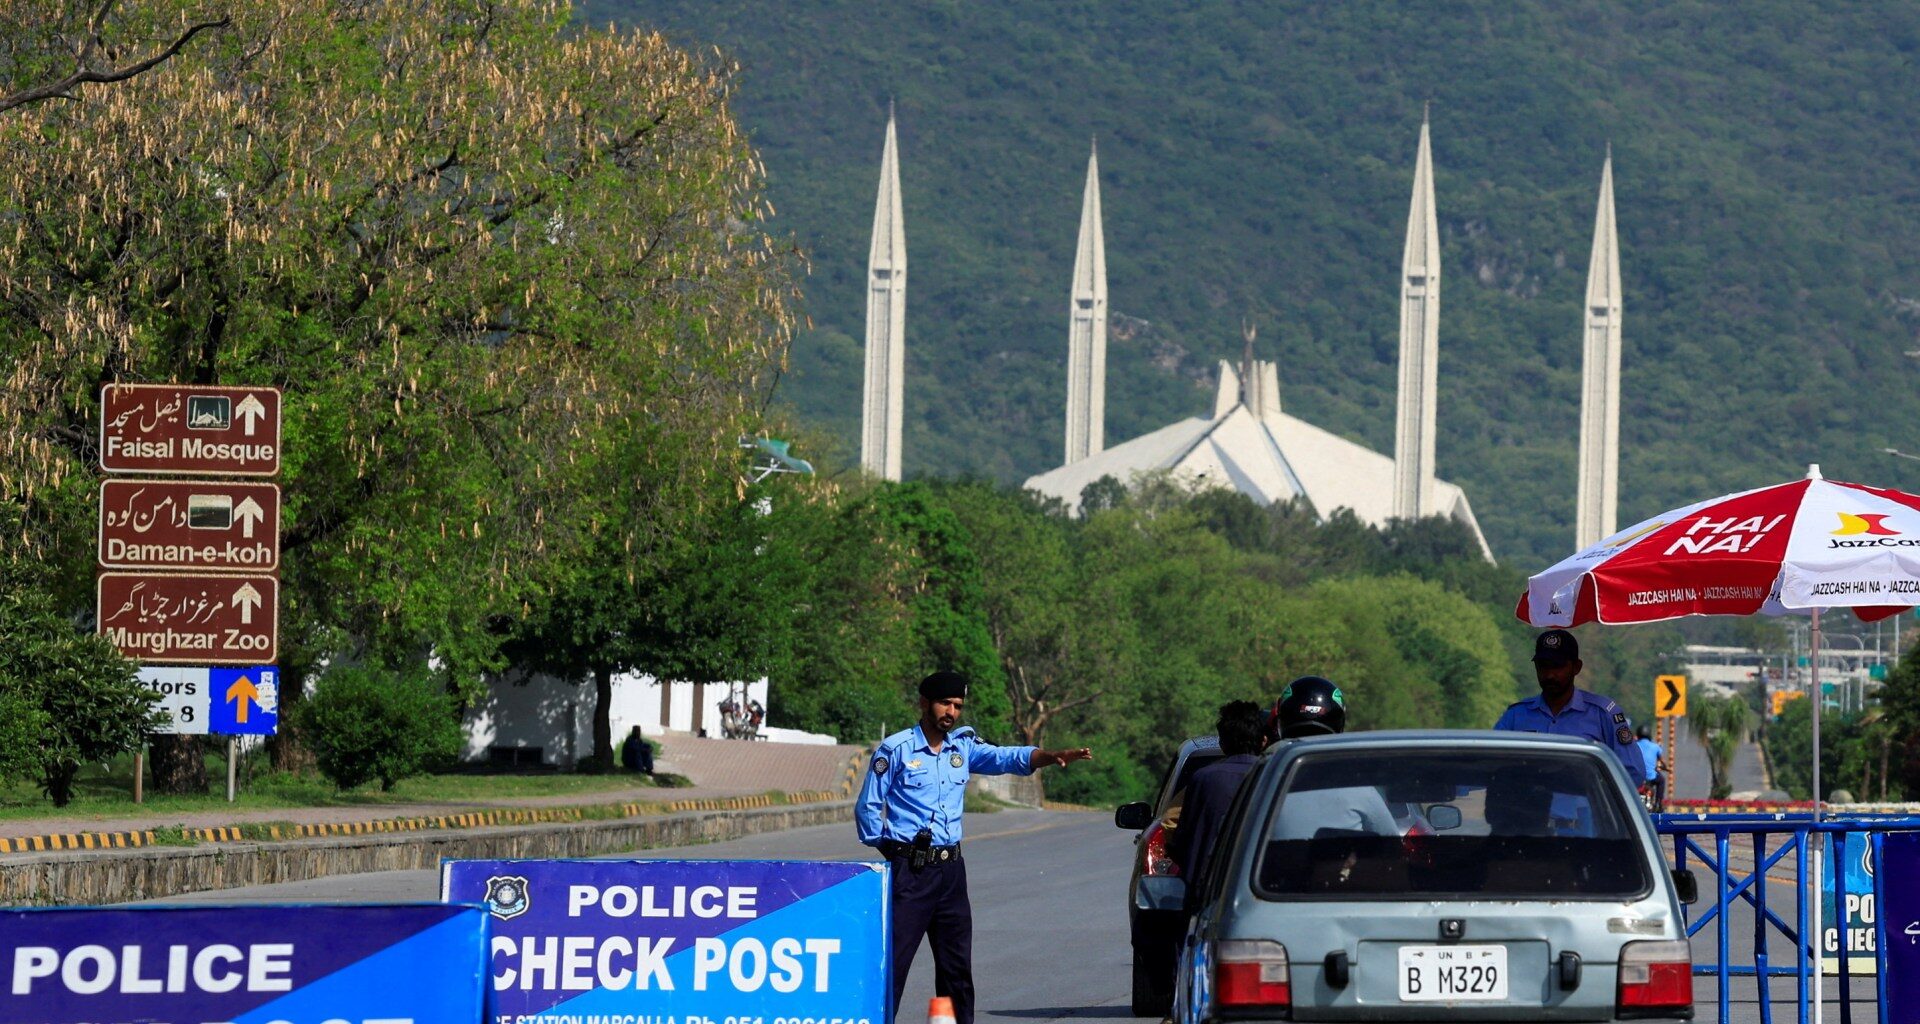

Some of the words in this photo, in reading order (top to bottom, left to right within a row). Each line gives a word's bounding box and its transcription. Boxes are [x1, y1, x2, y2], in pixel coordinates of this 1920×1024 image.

[107, 403, 144, 434] مسجد
[139, 392, 181, 432] فیصل
[107, 436, 174, 458] Faisal
[182, 438, 274, 465] Mosque
[107, 487, 145, 527] کوہ
[133, 496, 187, 533] دامن
[1685, 514, 1788, 535] HAI
[107, 538, 271, 564] Daman-e-koh
[1663, 534, 1766, 555] NA!
[105, 581, 146, 621] گھر
[1628, 589, 1668, 606] JAZZCASH
[1670, 588, 1684, 602] HAI
[1686, 588, 1697, 600] NA
[1704, 586, 1740, 599] JAZZCASH
[1811, 582, 1851, 595] JAZZCASH
[1853, 581, 1867, 593] HAI
[1869, 581, 1880, 593] NA
[171, 591, 224, 624] مرغزار
[105, 627, 218, 654] Murghzar
[223, 628, 270, 650] Zoo
[568, 885, 758, 918] POLICE
[12, 943, 294, 994] POLICE
[492, 936, 677, 990] CHECK
[693, 938, 841, 992] POST
[1408, 967, 1422, 994] B
[1438, 966, 1497, 994] M329
